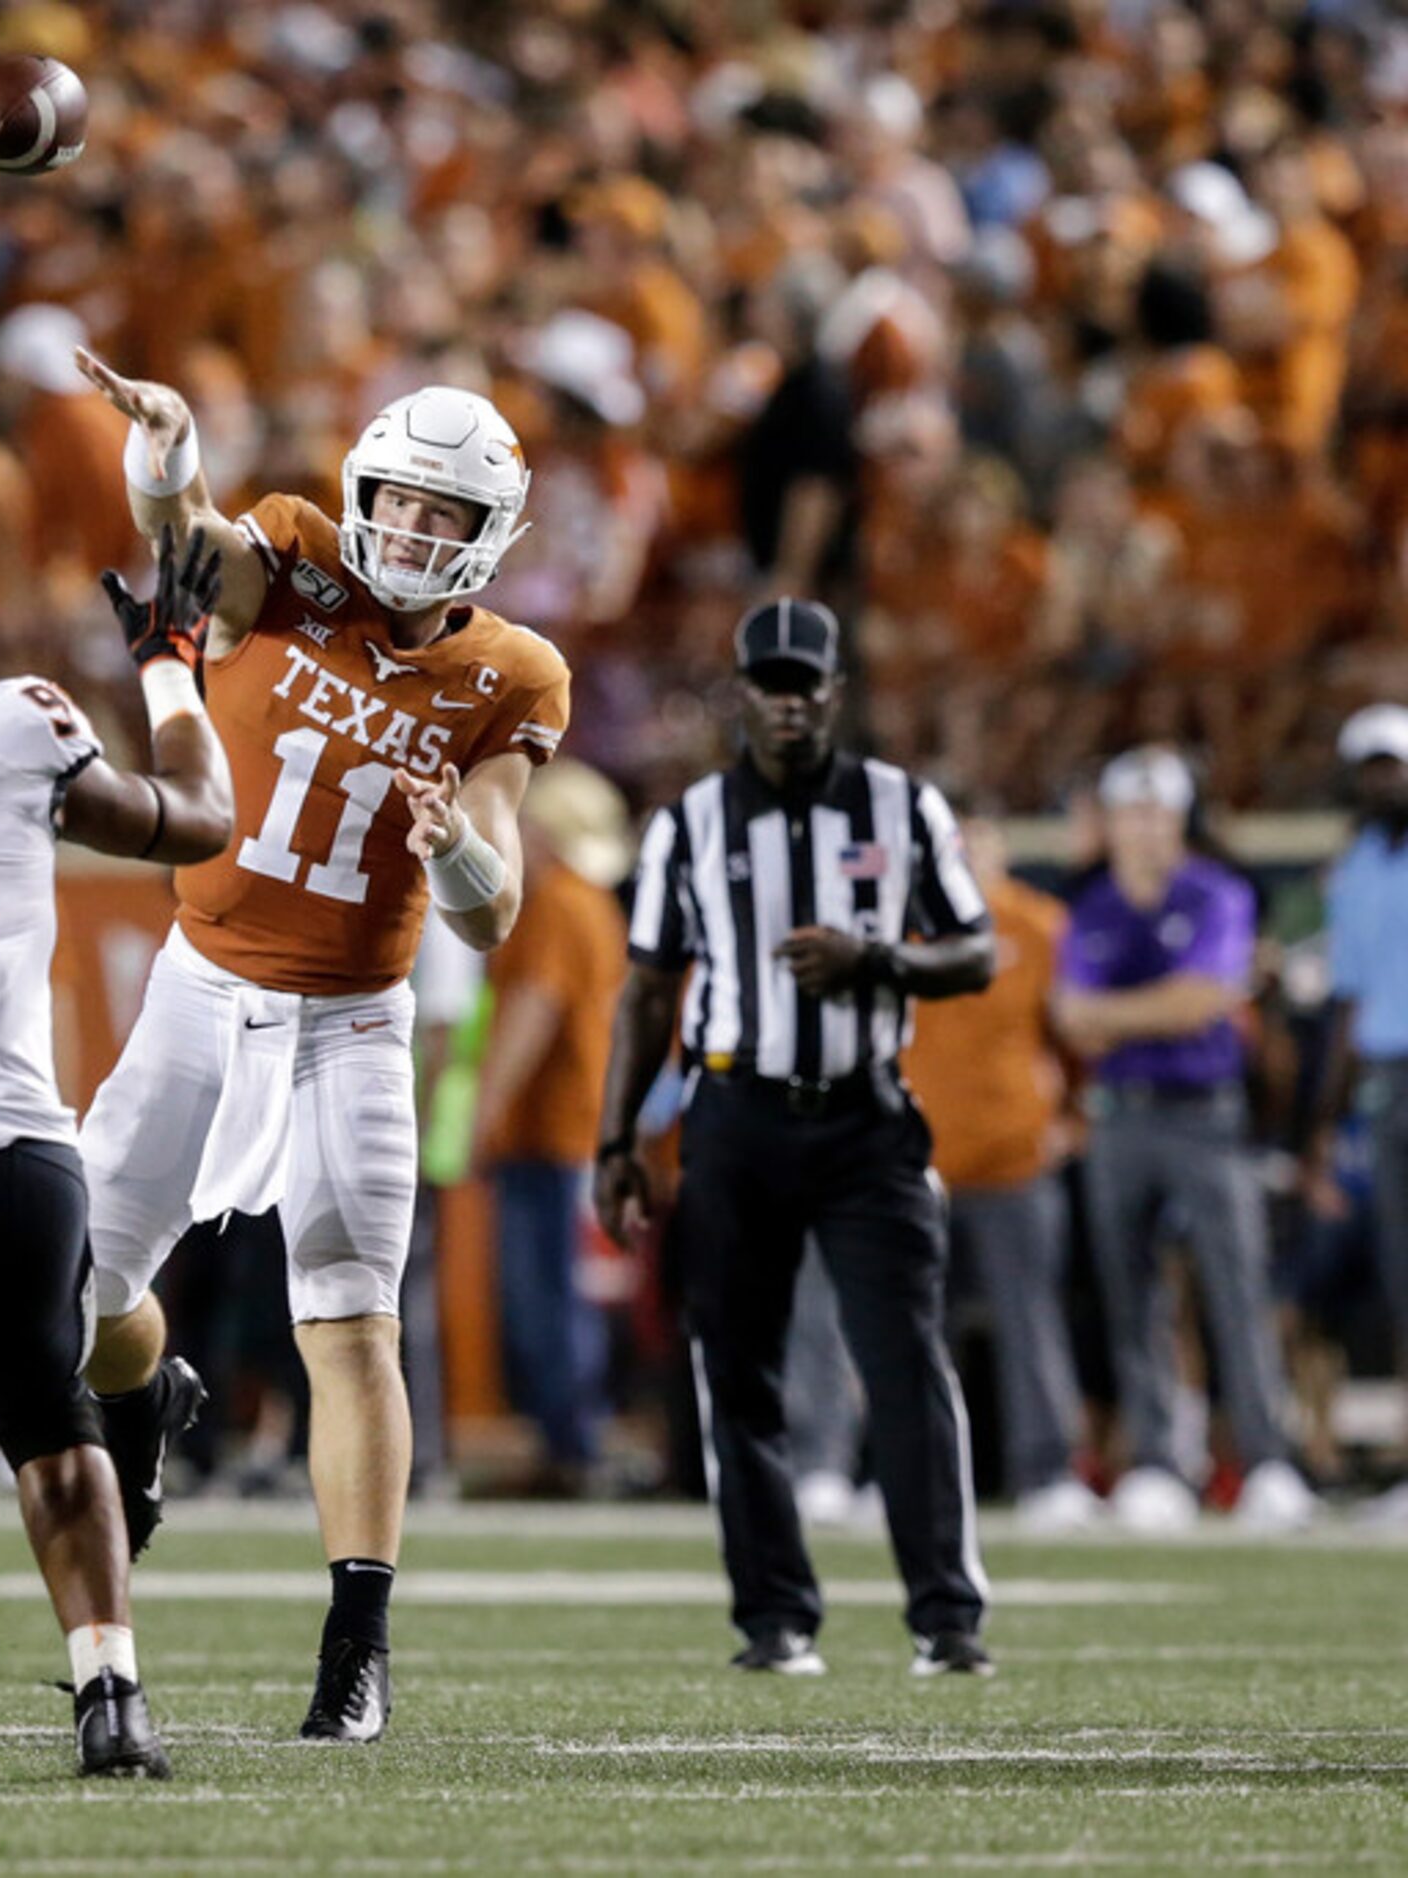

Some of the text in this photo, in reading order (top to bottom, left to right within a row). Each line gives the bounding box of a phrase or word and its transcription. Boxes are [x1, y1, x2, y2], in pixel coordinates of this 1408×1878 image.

[295, 561, 345, 610] 150
[273, 644, 451, 775] TEXAS
[476, 666, 499, 695] C
[235, 726, 394, 904] 11
